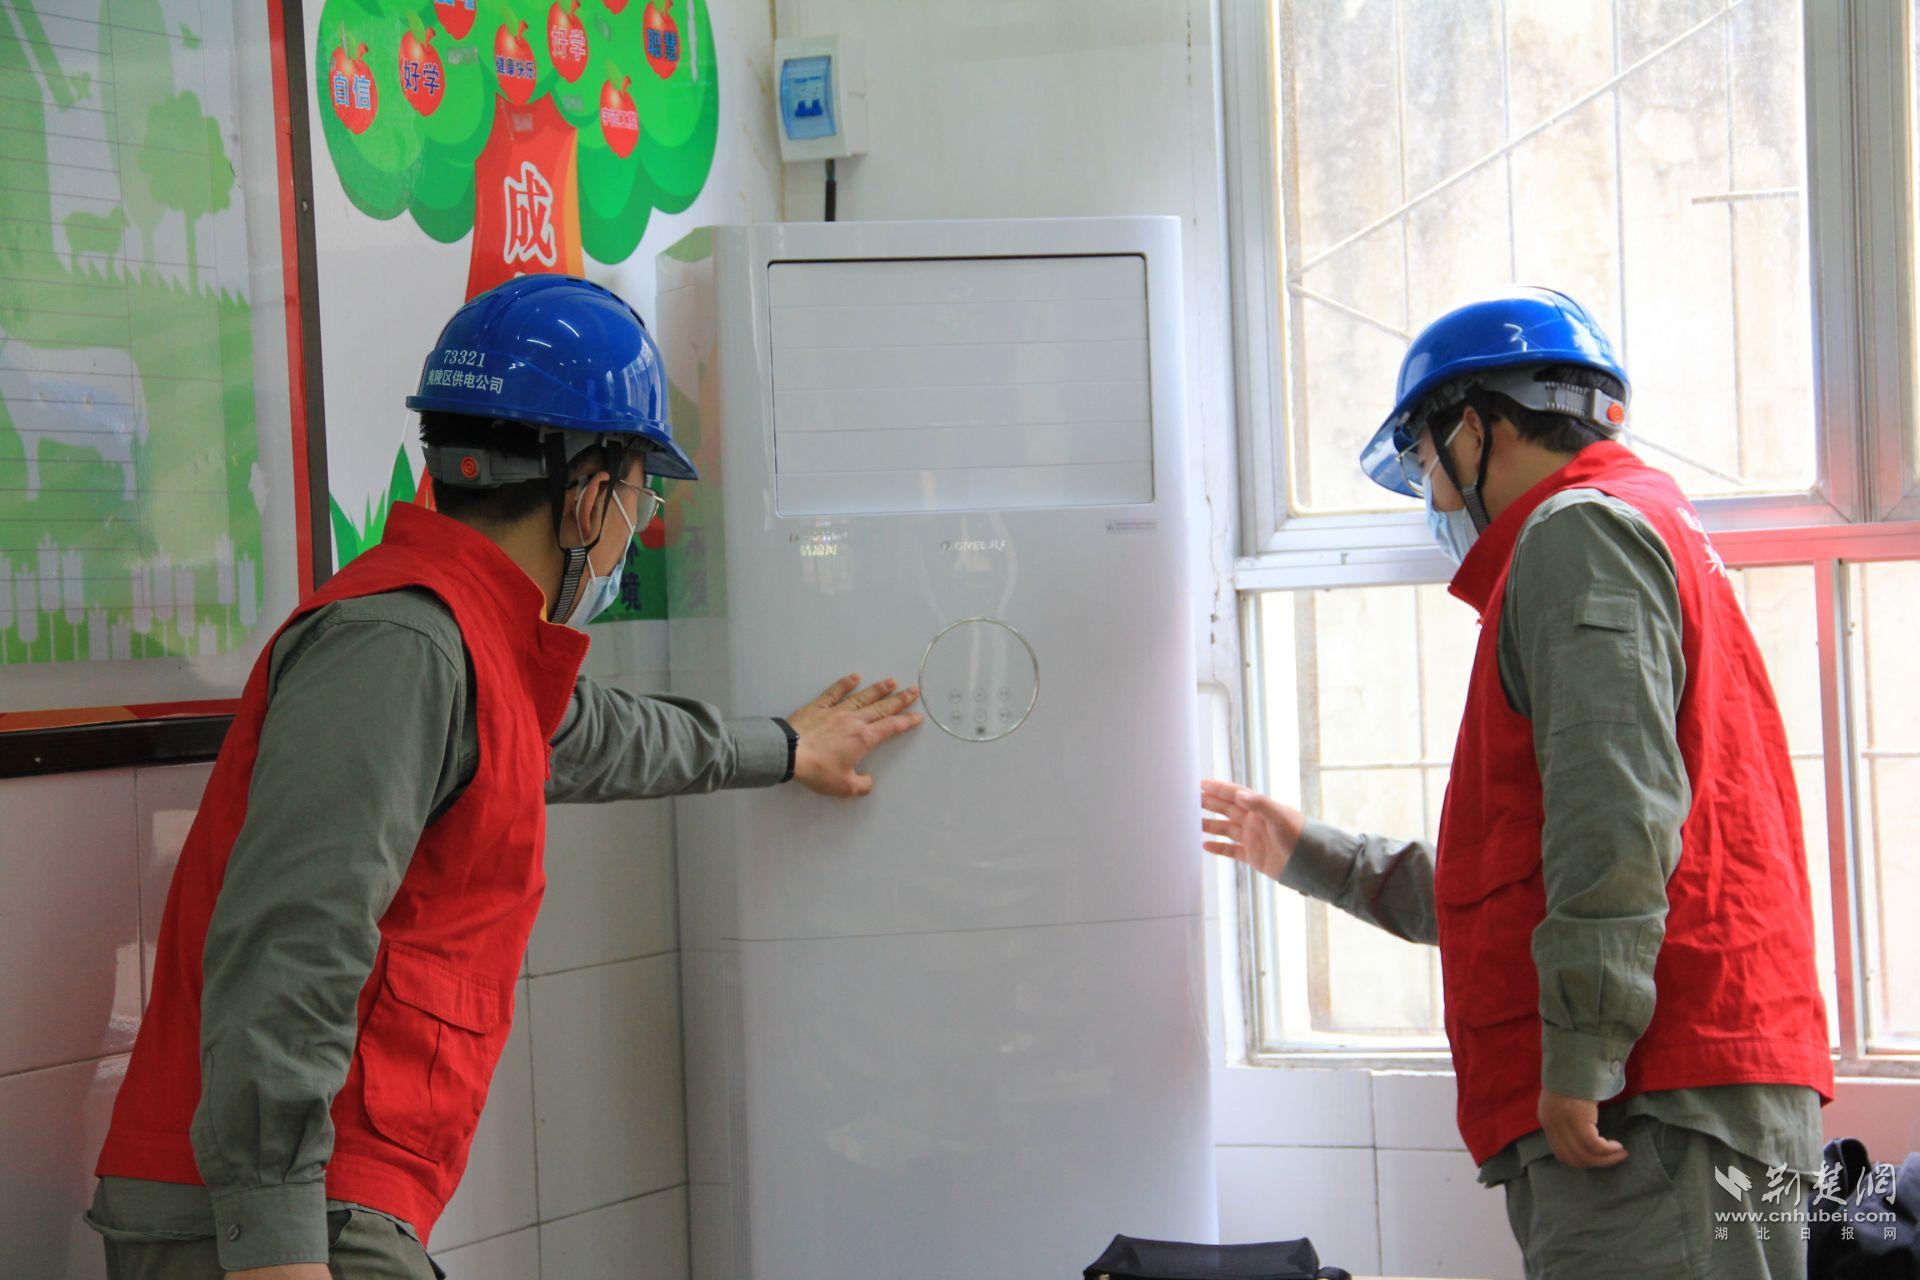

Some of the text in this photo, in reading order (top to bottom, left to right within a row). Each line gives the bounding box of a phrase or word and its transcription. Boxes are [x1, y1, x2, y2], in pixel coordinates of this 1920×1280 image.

[334, 71, 371, 110] 自信
[403, 58, 441, 96] 好学
[443, 349, 486, 368] 73321
[427, 369, 504, 394] 夷陵区供电公司
